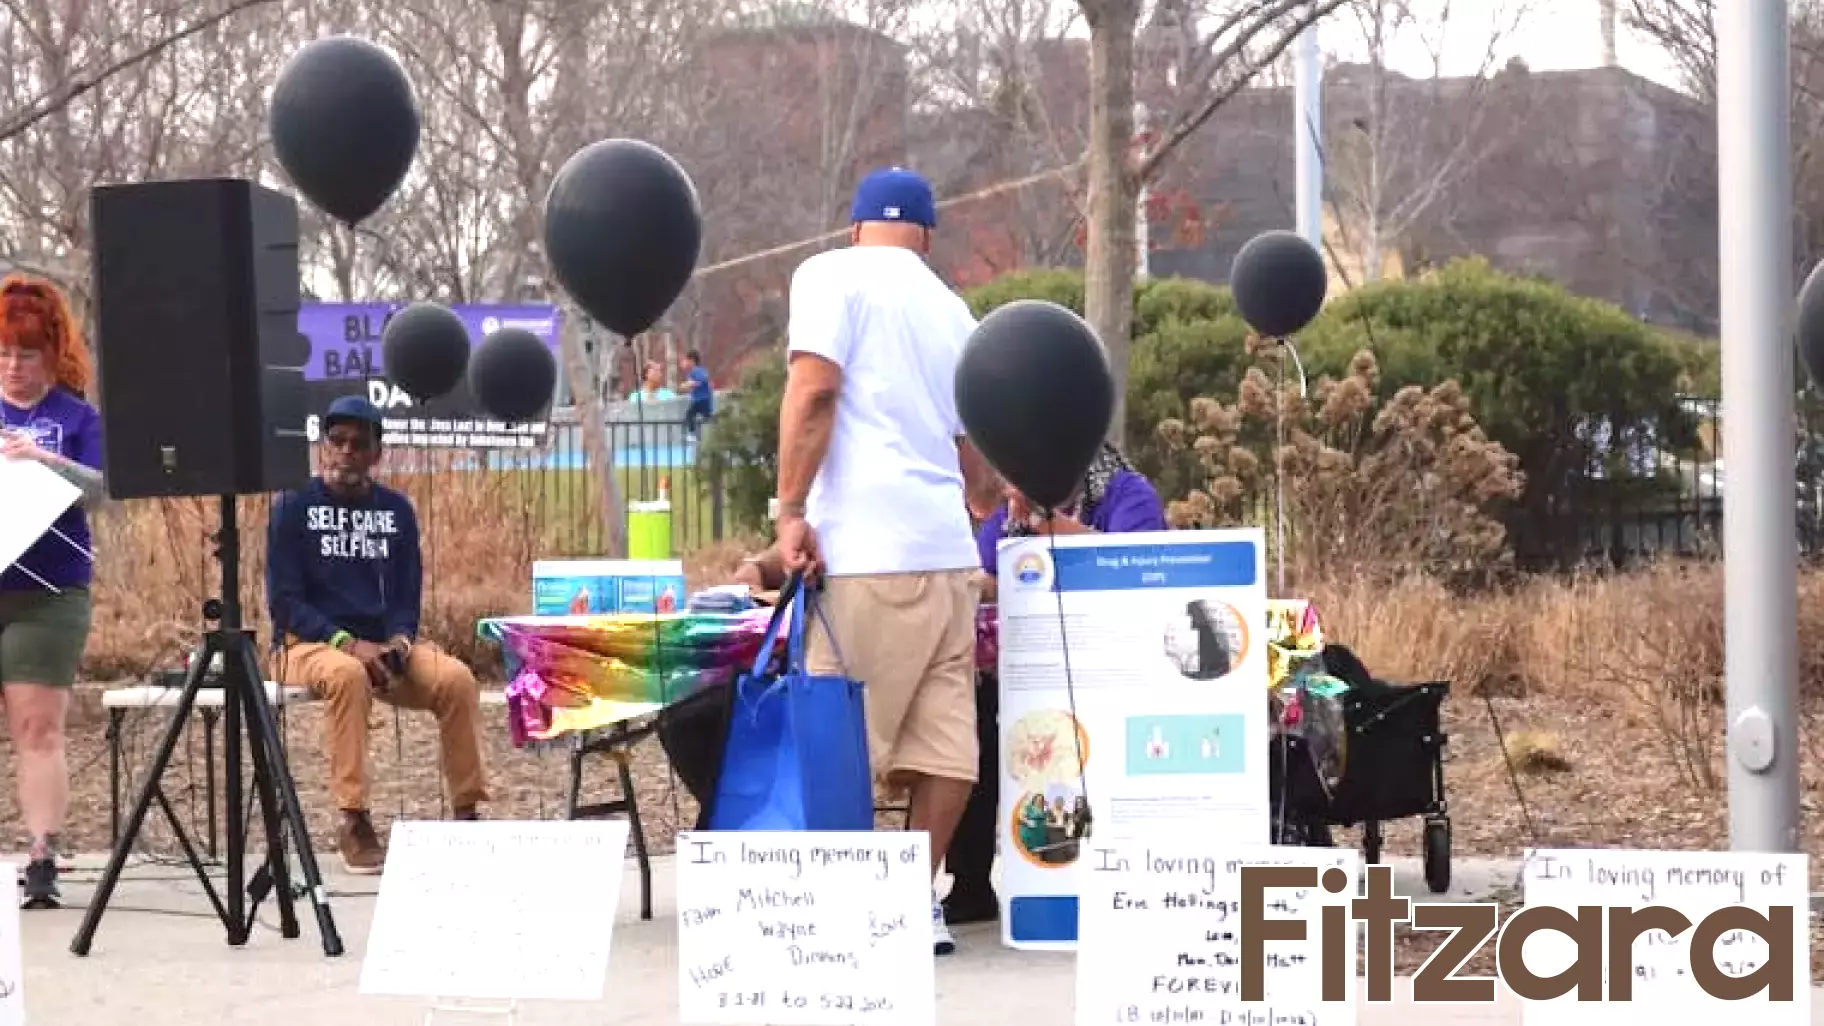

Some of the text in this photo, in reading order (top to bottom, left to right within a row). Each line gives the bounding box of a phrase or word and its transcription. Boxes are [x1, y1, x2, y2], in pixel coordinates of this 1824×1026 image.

[343, 313, 391, 342] BL
[324, 350, 382, 377] BAL
[367, 380, 413, 409] DA
[307, 505, 397, 534] SELF CARE
[691, 841, 920, 880] In loving memory of
[1094, 849, 1130, 872] In
[1146, 848, 1216, 895] loving
[1536, 856, 1788, 904] In loving memory of
[781, 989, 808, 1009] to
[1152, 975, 1239, 994] FOREV
